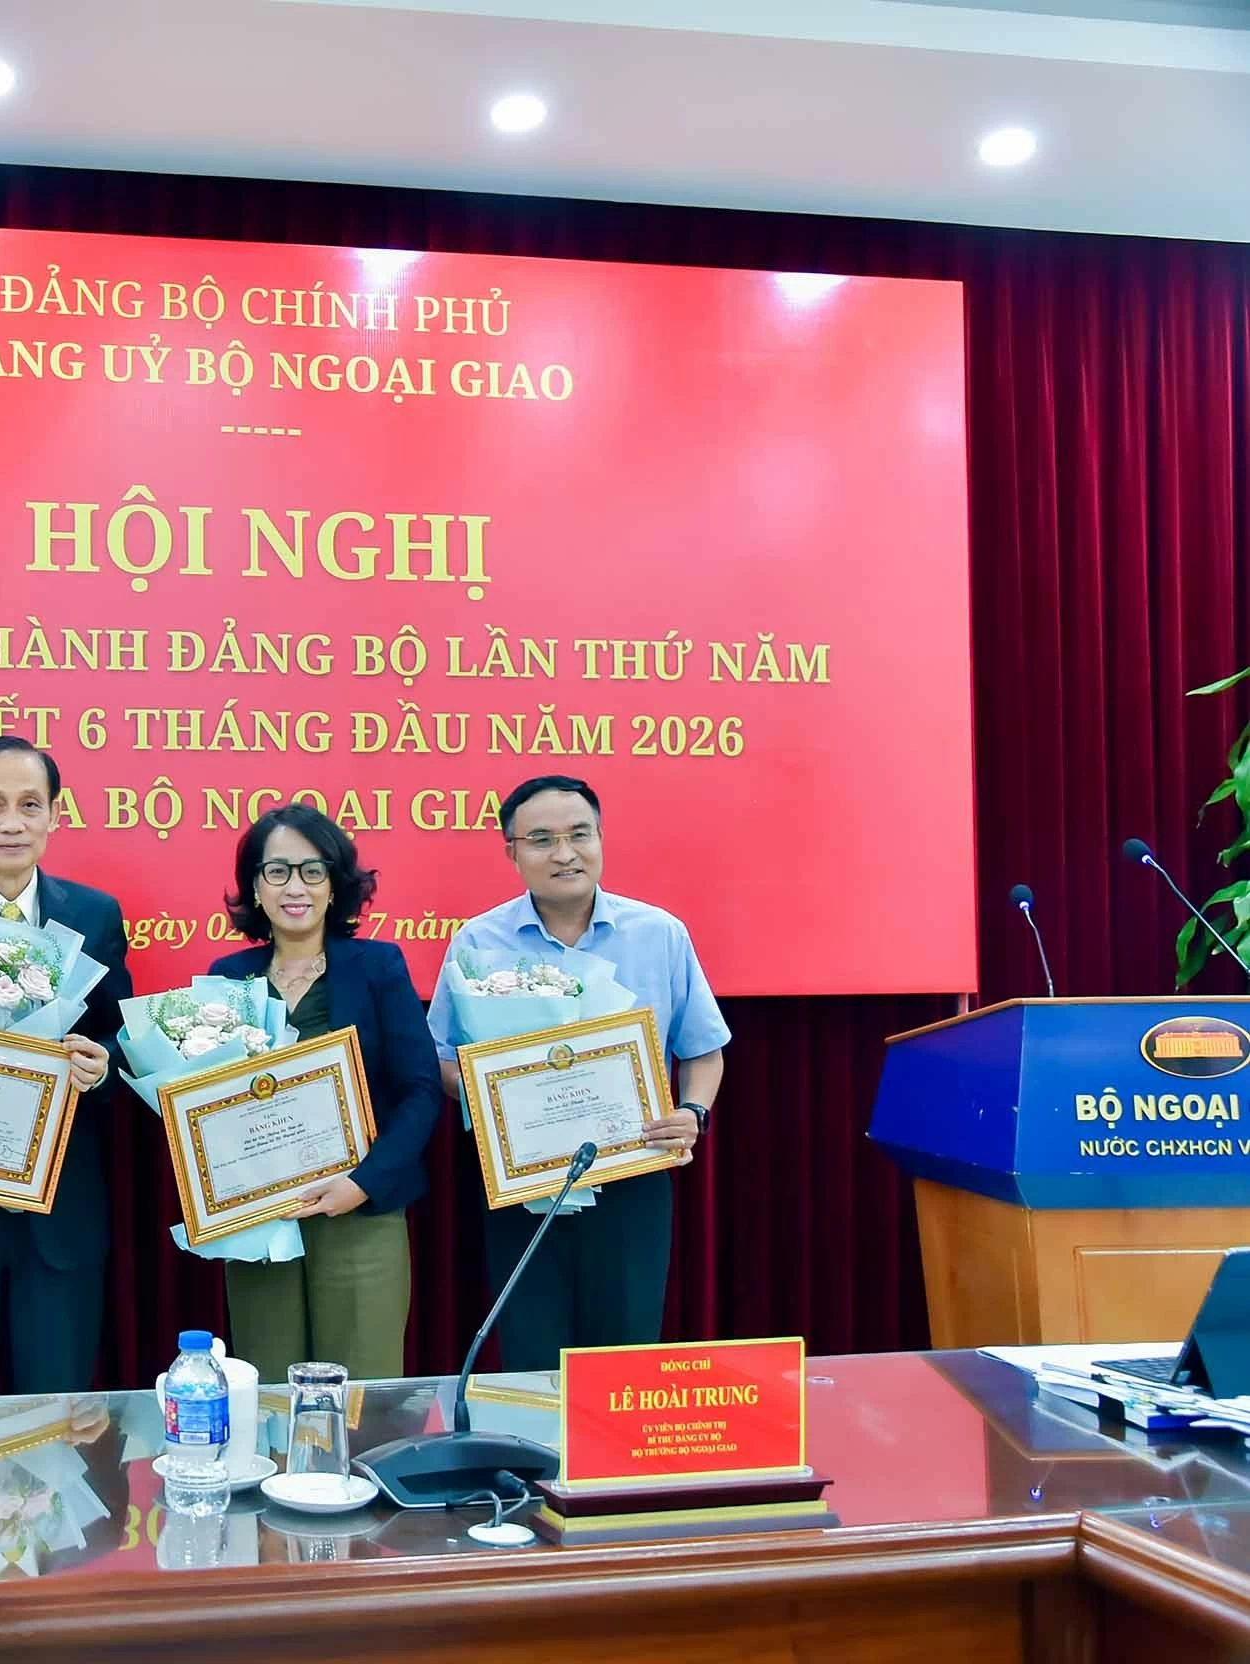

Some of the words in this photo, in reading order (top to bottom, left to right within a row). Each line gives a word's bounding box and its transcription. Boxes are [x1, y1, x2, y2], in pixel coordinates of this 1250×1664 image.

[0, 263, 143, 319] ĐẢNG
[159, 274, 226, 330] BỘ
[241, 280, 400, 332] CHÍNH
[415, 287, 510, 336] PHỦ
[100, 333, 171, 384] UỶ
[185, 340, 255, 395] BỘ
[270, 351, 435, 402] NGOẠI
[449, 361, 573, 400] GIAO
[25, 484, 212, 593] HỘI
[242, 508, 491, 601] NGHỊ
[168, 616, 334, 676] ĐẢNG
[352, 624, 427, 687] BỘ
[445, 626, 557, 678] LẦN
[572, 630, 694, 681] THỨ
[709, 634, 830, 684] NĂM
[77, 707, 107, 749] 6
[123, 699, 333, 753] THÁNG
[350, 701, 469, 753] ĐẦU
[487, 703, 615, 755] NĂM
[629, 715, 744, 757] 2026
[104, 775, 183, 840] BỘ
[409, 789, 503, 831] GIA
[367, 912, 387, 937] 7
[1075, 1087, 1123, 1129] BỘ
[1133, 1094, 1240, 1129] NGOẠI
[1080, 1135, 1140, 1156] NƯỚC
[1146, 1139, 1233, 1156] CHXHCN
[609, 1385, 634, 1412] LÊ
[639, 1383, 688, 1410] HOÀI
[692, 1384, 759, 1407] TRUNG
